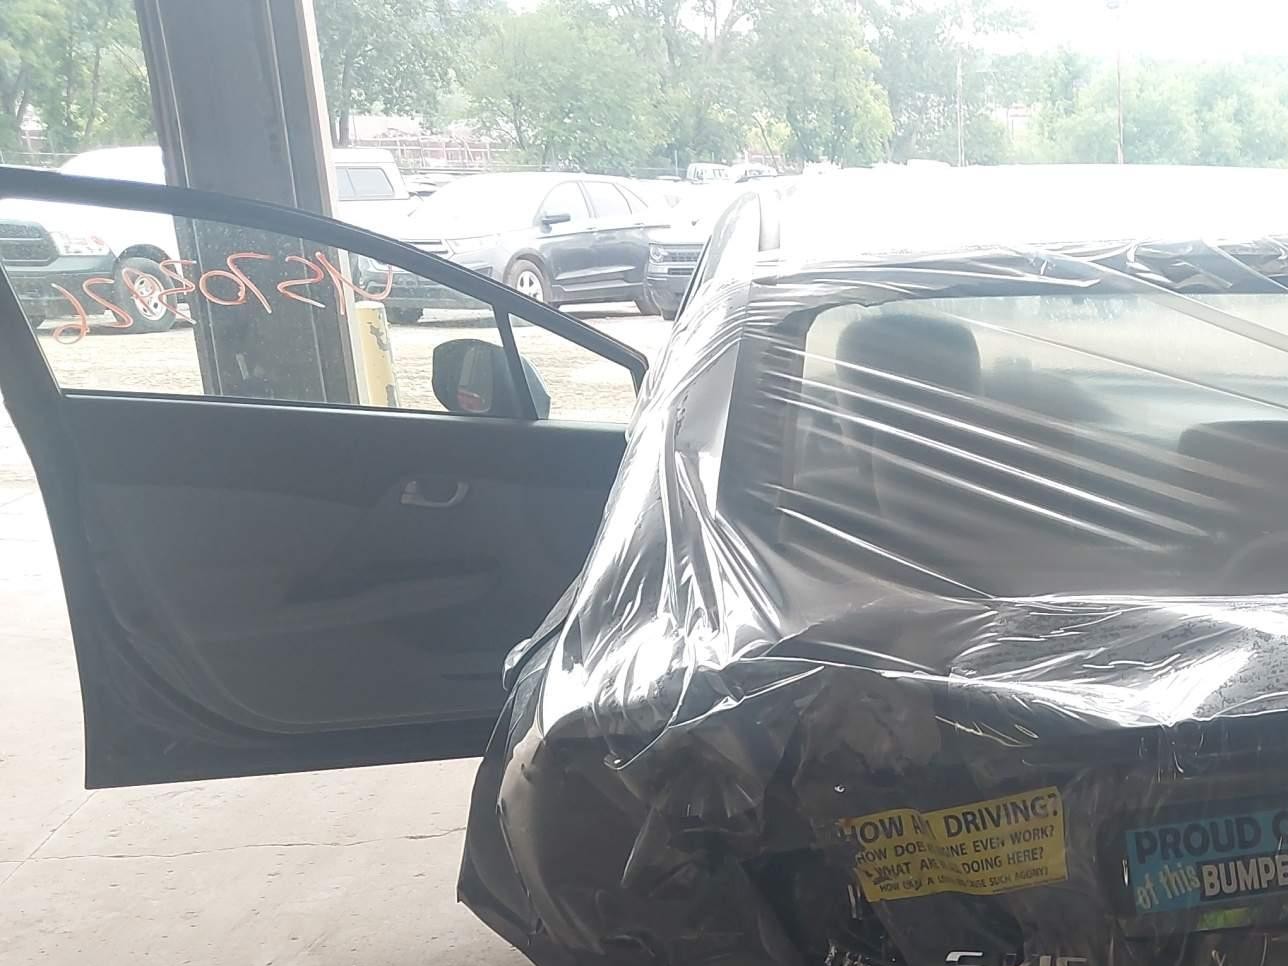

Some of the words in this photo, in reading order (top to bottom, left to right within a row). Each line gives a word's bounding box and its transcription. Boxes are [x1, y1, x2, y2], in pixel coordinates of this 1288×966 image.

[943, 792, 1059, 839] DRIVING?
[856, 847, 888, 865] HOW
[972, 836, 1006, 854] EVEN
[1010, 824, 1056, 844] WORK?
[962, 857, 1003, 875] DOING
[1007, 846, 1045, 865] HERE?
[1135, 815, 1263, 865] PROUD
[1160, 863, 1200, 900] this
